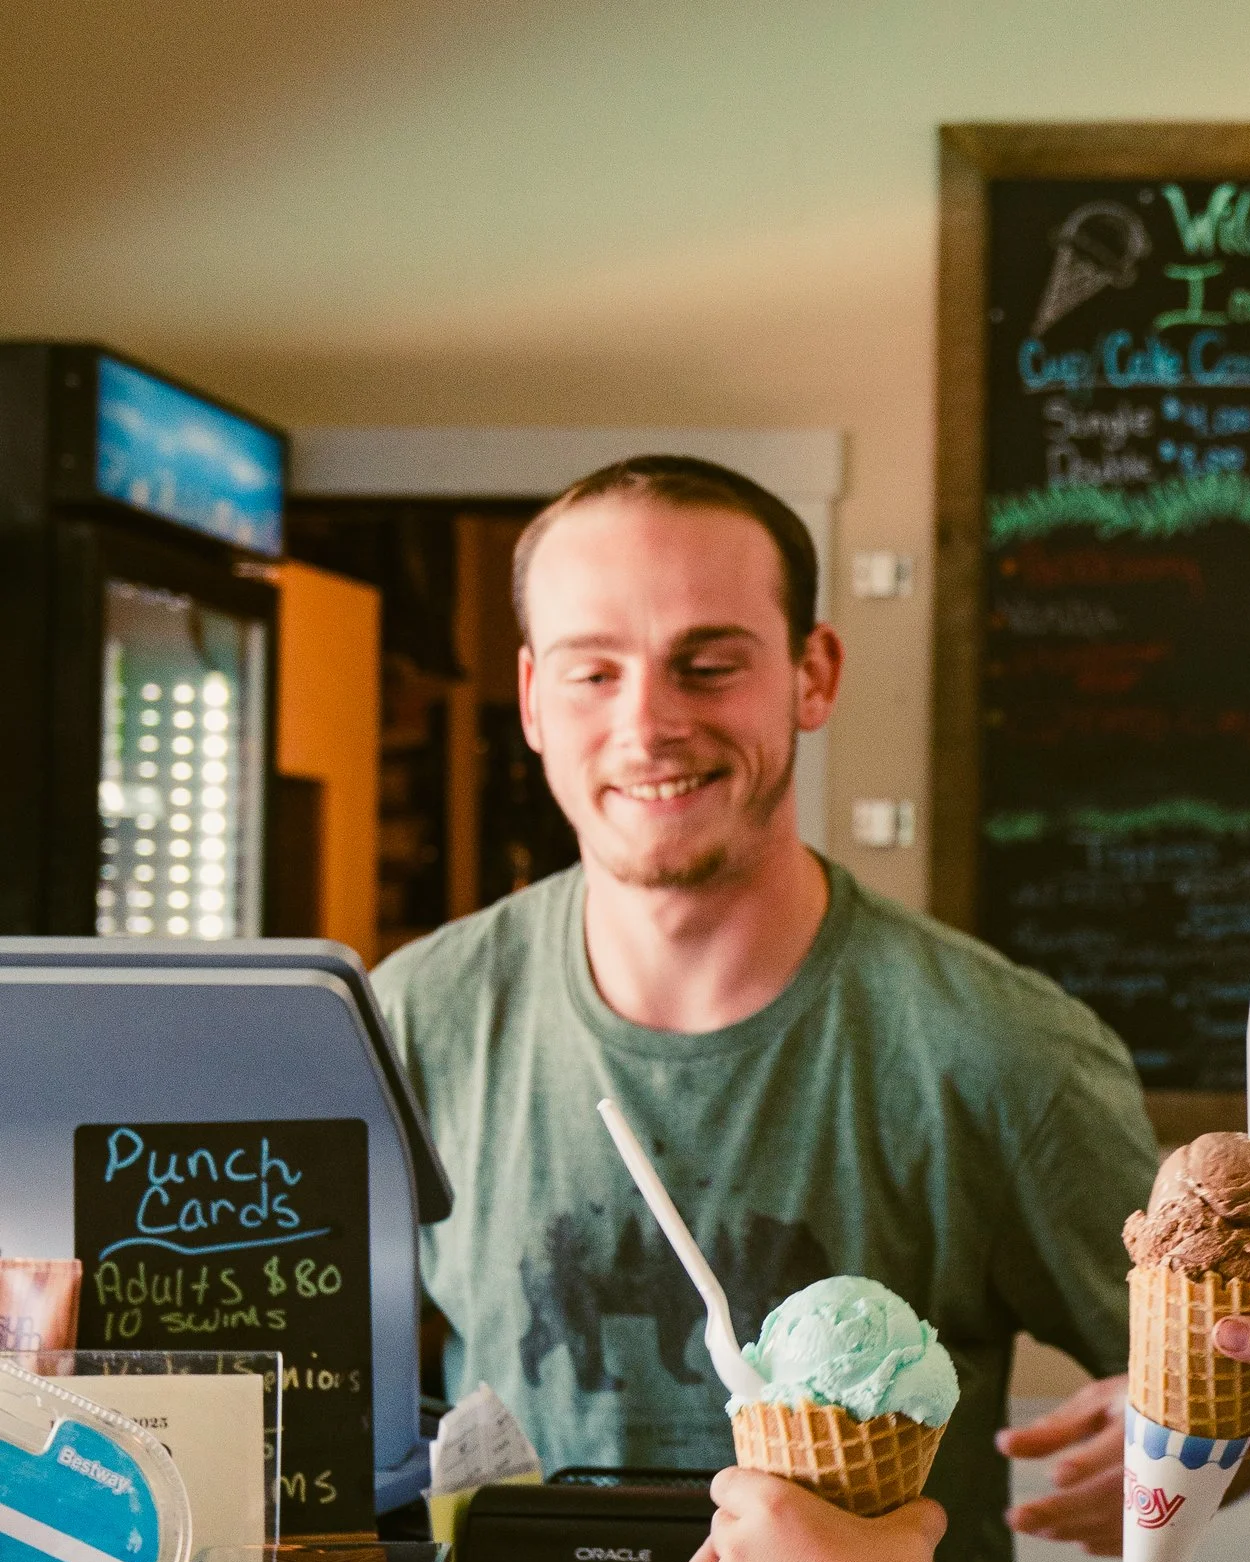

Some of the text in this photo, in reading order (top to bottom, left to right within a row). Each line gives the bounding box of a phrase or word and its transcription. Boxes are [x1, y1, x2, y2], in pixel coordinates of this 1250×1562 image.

[104, 1127, 302, 1187] Punch
[137, 1181, 301, 1234] Cards
[95, 1256, 342, 1307] Adults $80
[103, 1304, 287, 1340] 10 swims
[56, 1444, 132, 1496] Bestway
[574, 1547, 651, 1562] ORACLE
